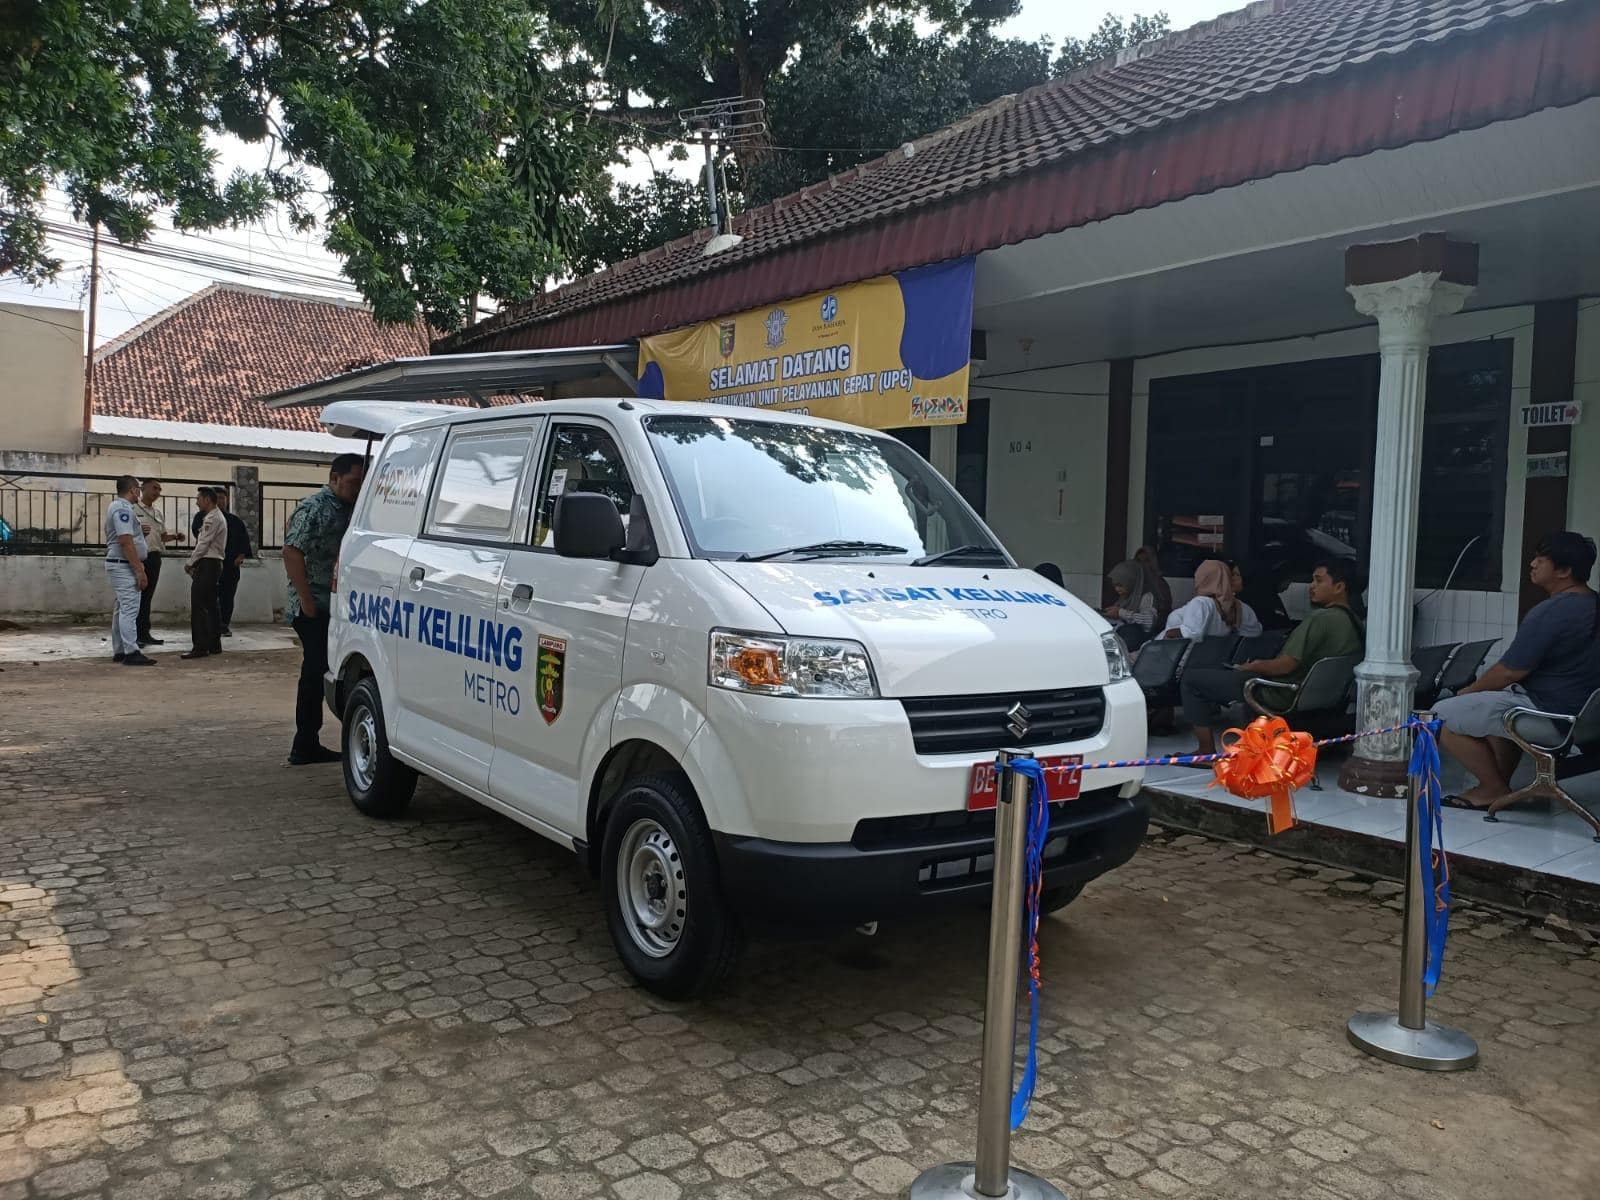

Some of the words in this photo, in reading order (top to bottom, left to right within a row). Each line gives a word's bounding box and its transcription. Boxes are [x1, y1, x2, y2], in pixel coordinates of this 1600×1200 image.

[709, 357, 779, 391] SELAMAT
[782, 343, 851, 379] DATANG
[758, 387, 780, 406] UNIT
[781, 378, 841, 403] PELAYANAN
[843, 372, 877, 395] CEPAT
[879, 367, 914, 395] (UPC)
[1521, 404, 1567, 425] TOILET
[1009, 440, 1022, 453] NO
[1025, 440, 1032, 452] 4
[814, 586, 943, 606] SAMSAT
[943, 587, 1067, 607] KELILING
[348, 590, 415, 639] SAMSAT
[418, 604, 524, 672] KELILING
[464, 669, 521, 716] METRO
[972, 765, 996, 794] BE
